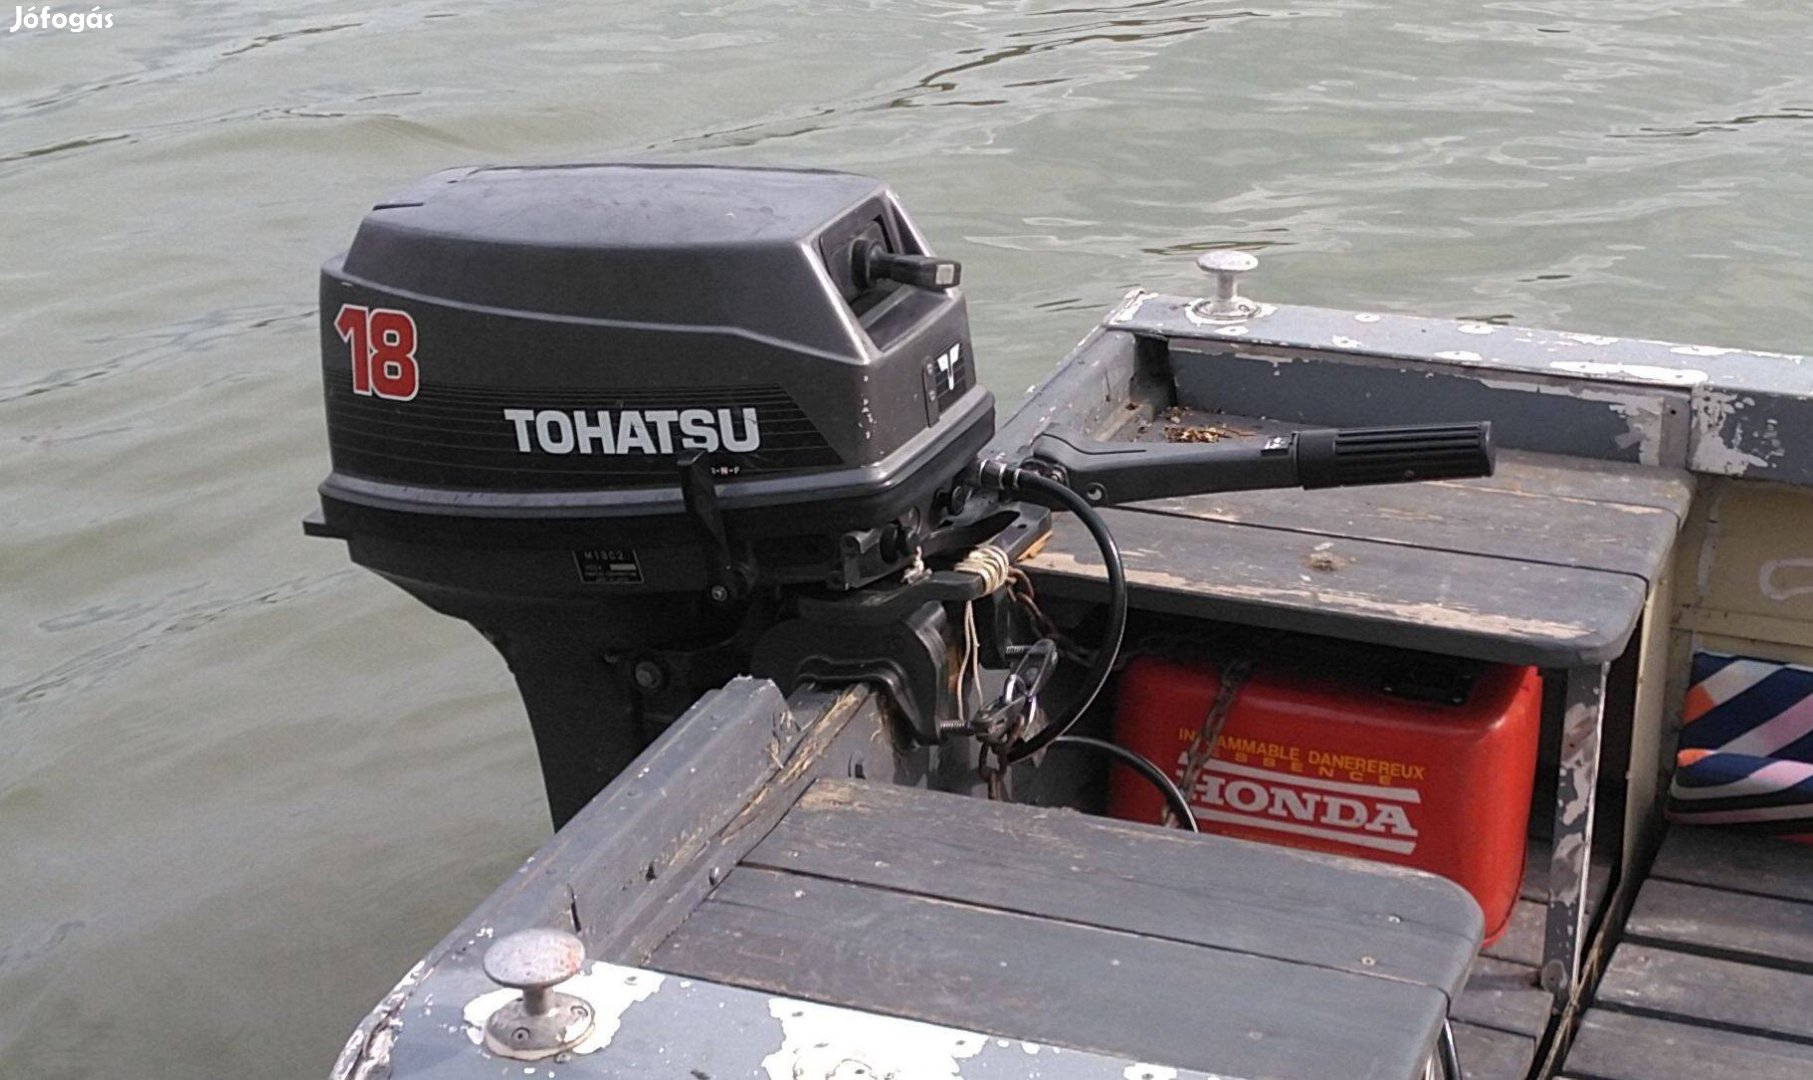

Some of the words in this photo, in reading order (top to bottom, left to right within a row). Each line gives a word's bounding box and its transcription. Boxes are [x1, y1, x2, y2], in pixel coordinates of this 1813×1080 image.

[334, 303, 419, 402] 18
[503, 407, 761, 455] TOHATSU
[1178, 727, 1300, 761] INAMMABLE
[1176, 769, 1419, 838] HONDA
